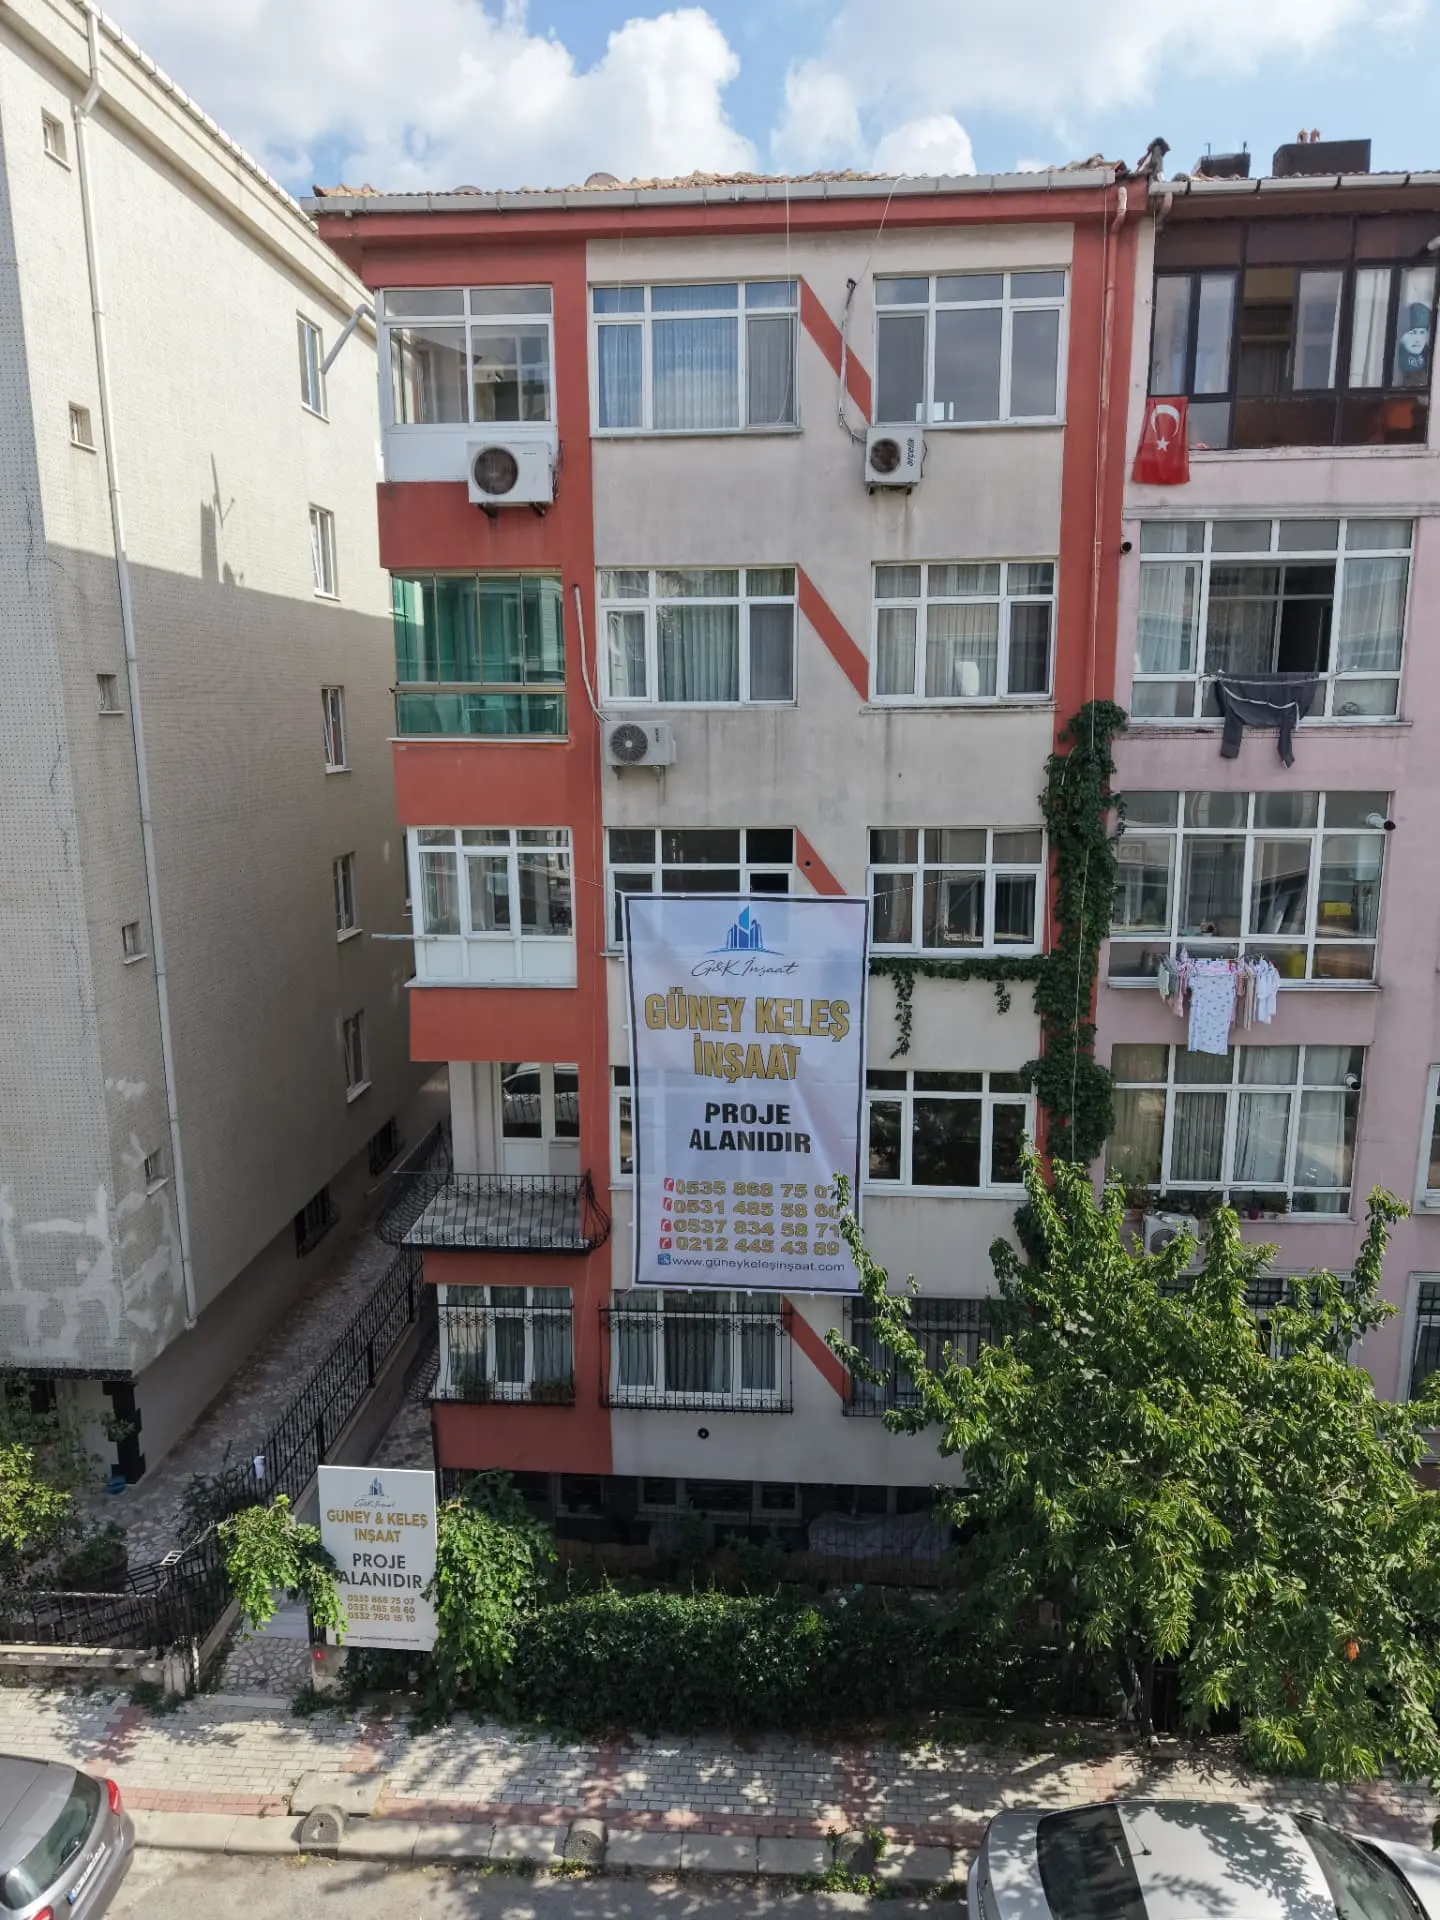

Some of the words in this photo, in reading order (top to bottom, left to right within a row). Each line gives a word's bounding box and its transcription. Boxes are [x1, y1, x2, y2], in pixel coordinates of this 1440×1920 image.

[644, 987, 746, 1032] GÜNEY
[755, 997, 850, 1042] KELEŞ
[693, 1033, 801, 1084] İNŞAAT
[705, 1102, 791, 1124] PROJE
[688, 1128, 811, 1153] ALANIDIR
[675, 1179, 727, 1196] 0535
[732, 1181, 774, 1198] 868
[780, 1183, 808, 1199] 75
[673, 1199, 725, 1215] 0531
[732, 1200, 774, 1217] 485
[781, 1202, 808, 1218] 58
[814, 1203, 841, 1220] 60
[673, 1218, 727, 1234] 0537
[733, 1220, 775, 1237] 834
[781, 1222, 808, 1237] 58
[815, 1223, 840, 1238] 71
[675, 1236, 729, 1252] 0212
[734, 1238, 775, 1254] 445
[780, 1240, 808, 1255] 43
[813, 1241, 840, 1256] 89
[326, 1509, 371, 1525] GÜNEY
[374, 1511, 384, 1525] &
[387, 1512, 428, 1529] KELEŞ
[354, 1527, 401, 1544] İNŞAAT
[352, 1553, 406, 1569] PROJE
[338, 1570, 422, 1589] ALANIDIR
[403, 1597, 415, 1605] 07
[403, 1606, 416, 1614] 60
[405, 1615, 416, 1623] 10
